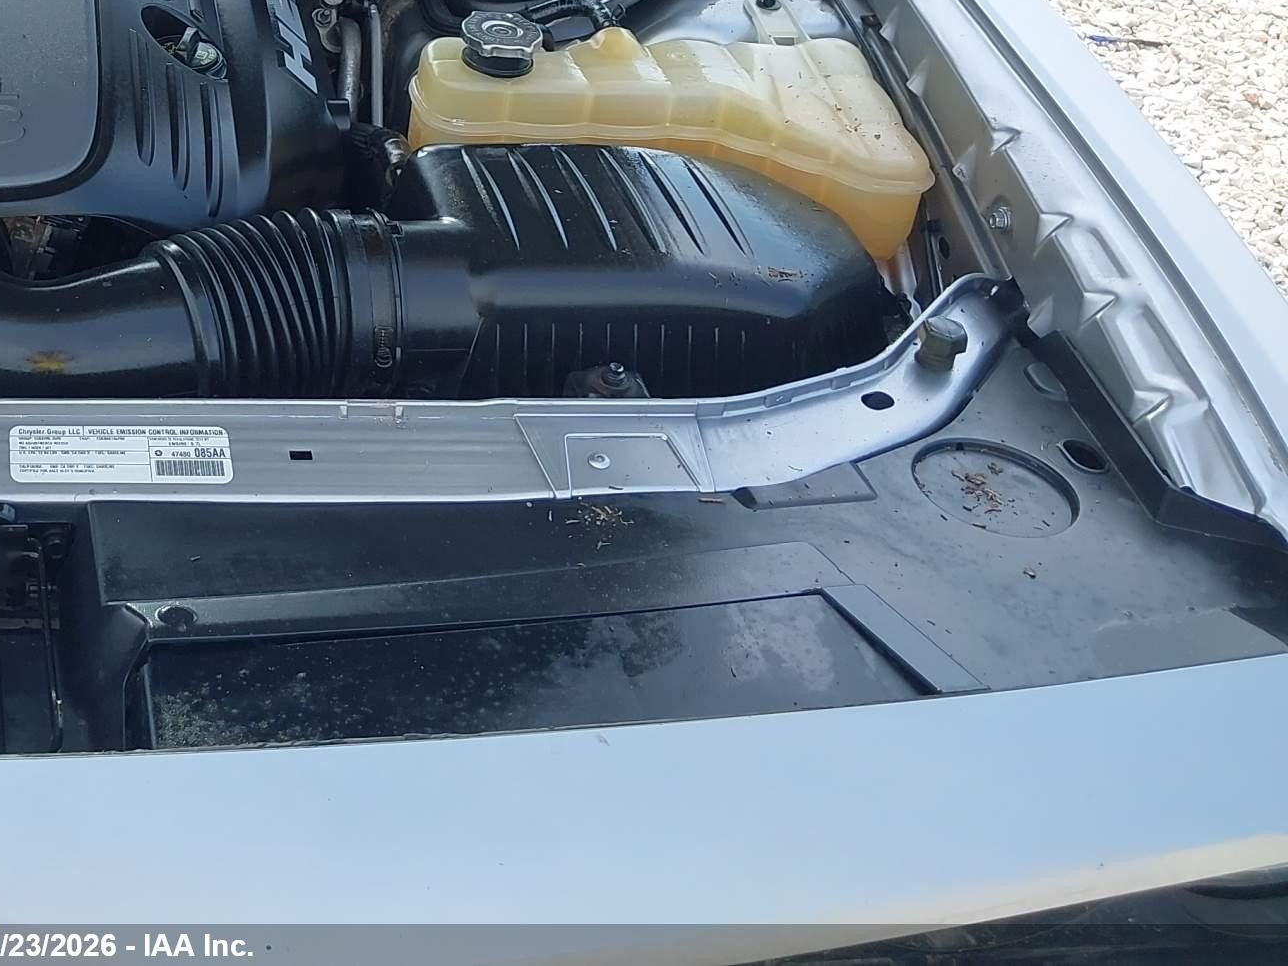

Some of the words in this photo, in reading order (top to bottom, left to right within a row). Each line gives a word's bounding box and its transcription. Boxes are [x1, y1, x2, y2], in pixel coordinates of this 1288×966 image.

[18, 428, 45, 437] Chrysler
[47, 428, 67, 436] Group
[194, 447, 226, 458] 085AA
